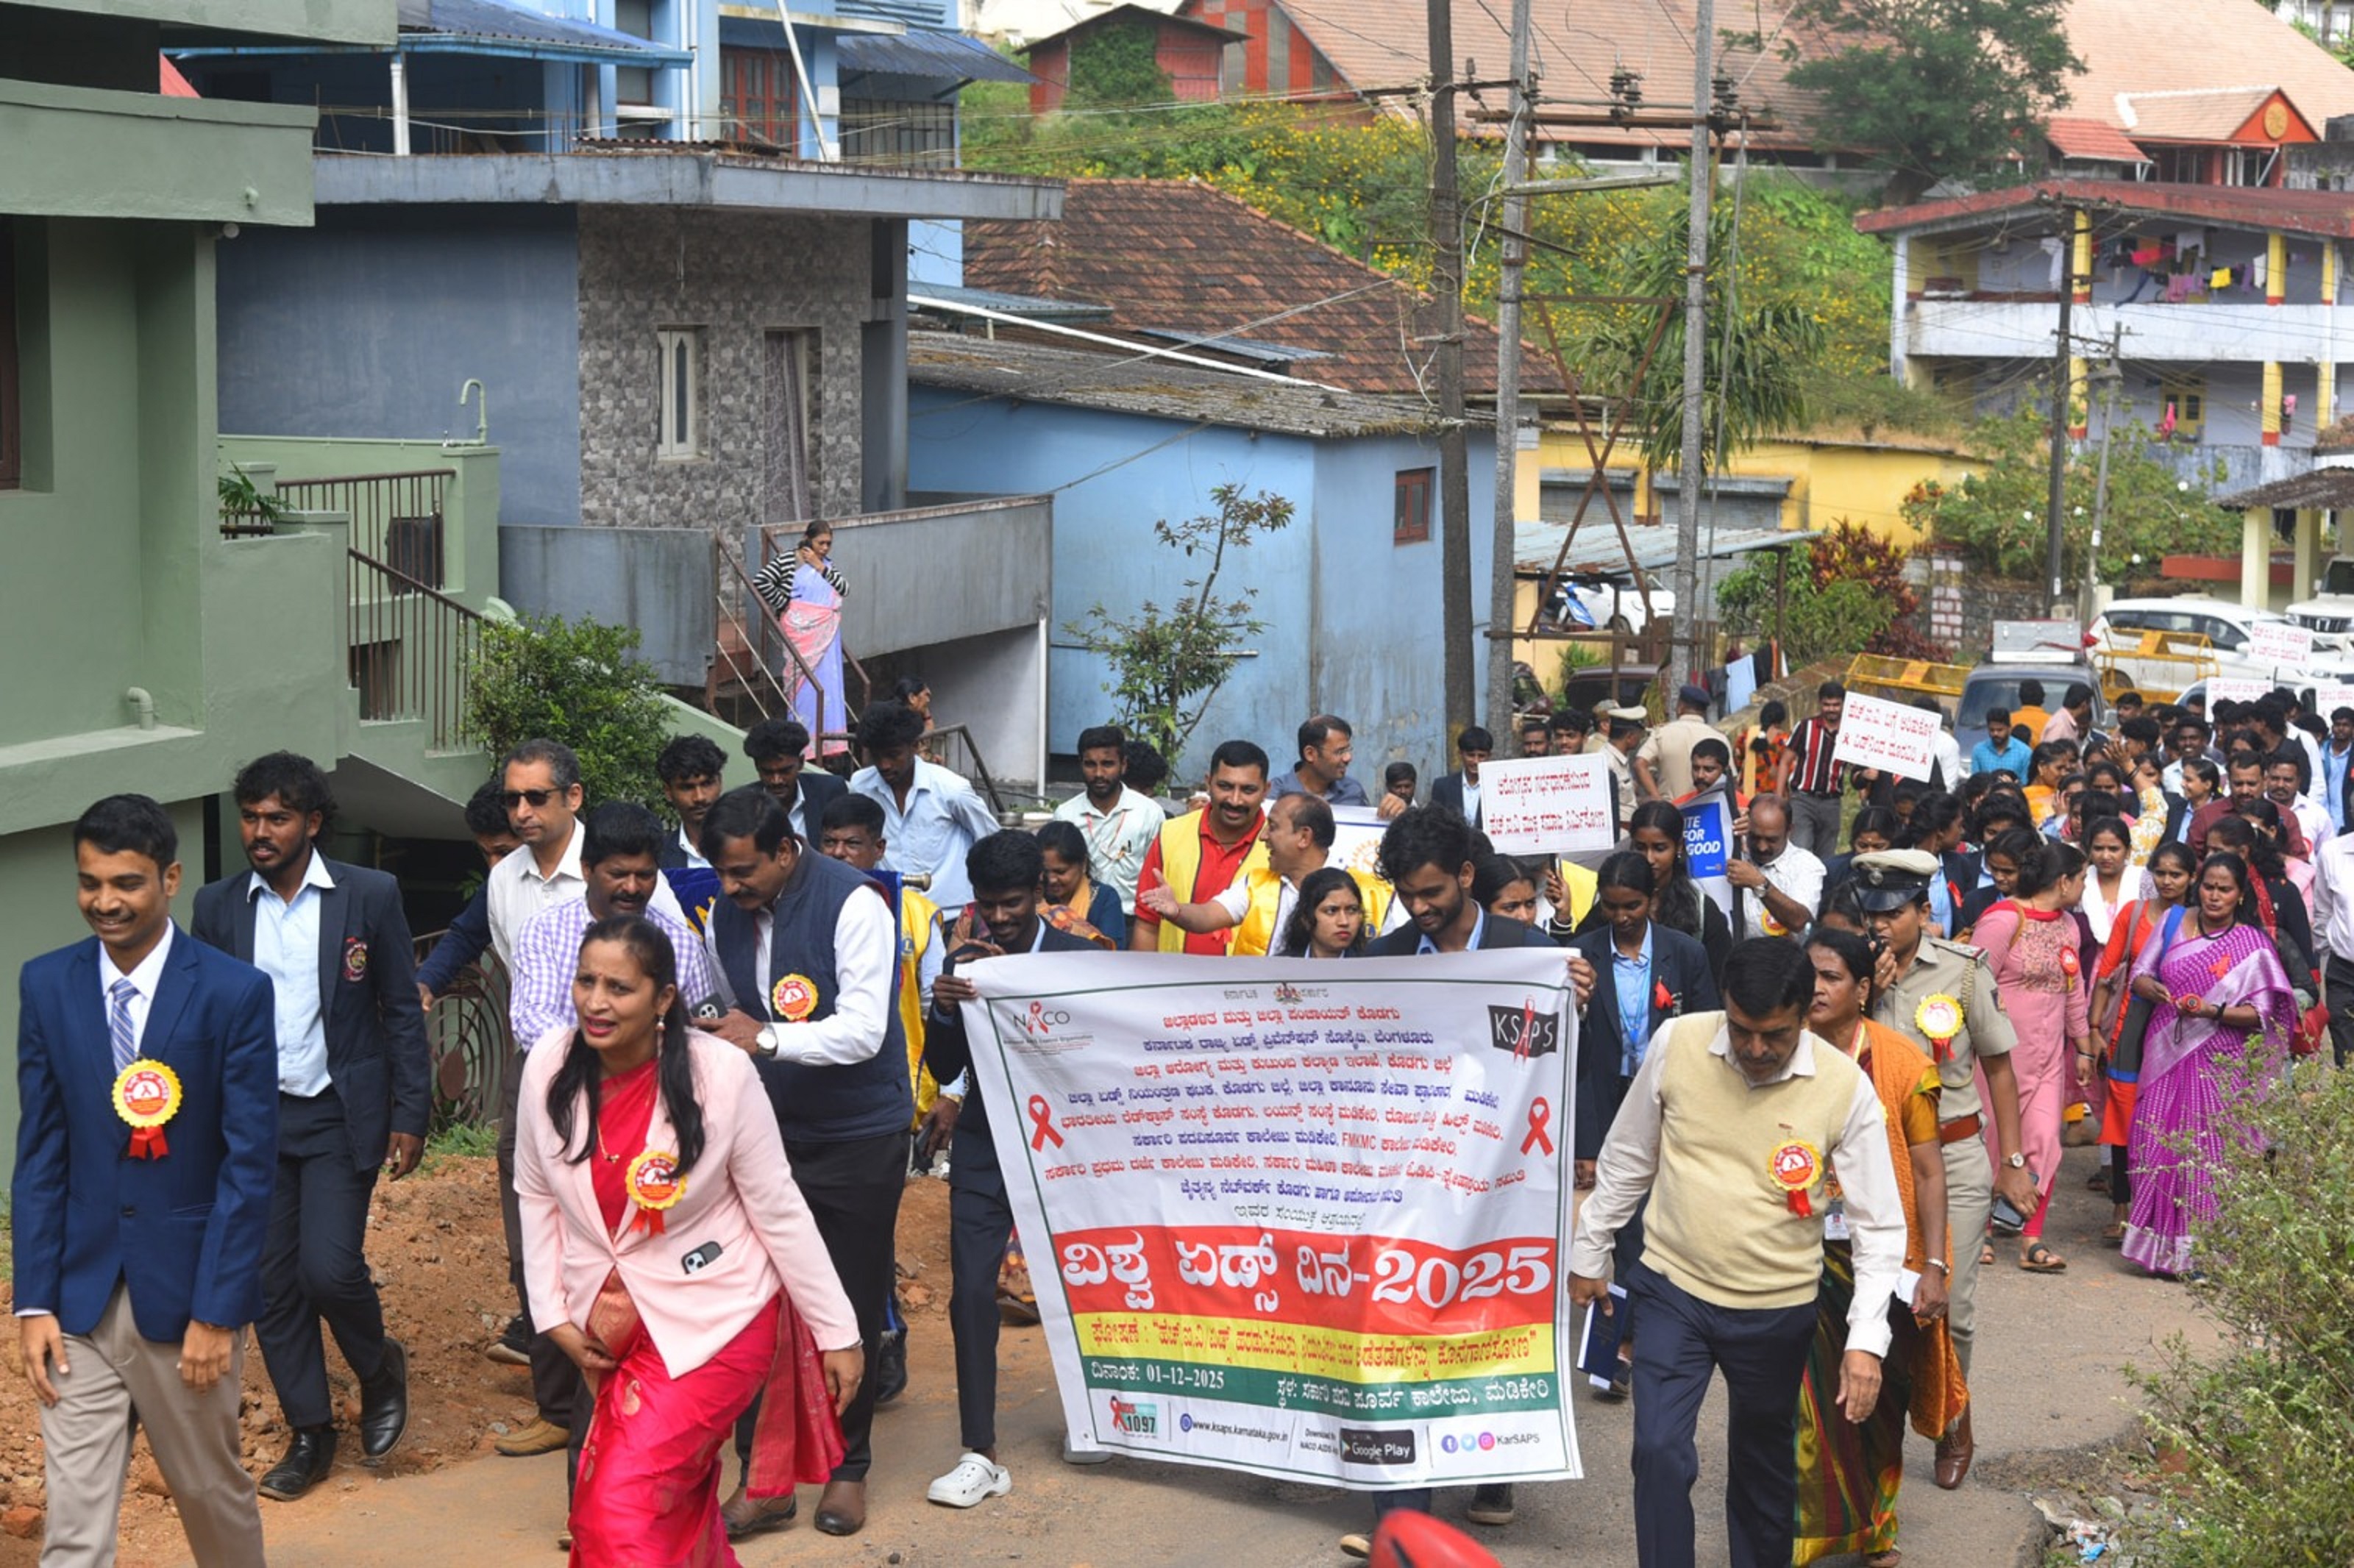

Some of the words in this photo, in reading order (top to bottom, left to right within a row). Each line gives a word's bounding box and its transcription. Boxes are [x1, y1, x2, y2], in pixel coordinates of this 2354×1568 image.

[1682, 829, 1704, 841] FOR
[1686, 841, 1721, 855] GOOD
[1013, 1004, 1070, 1032] NACO
[1223, 1011, 1252, 1027] ಮತ್ತು
[1257, 1009, 1284, 1025] ಜಿಲ್ಲಾ
[1288, 1005, 1351, 1021] ಪಂಚಾಯತ್
[1357, 1005, 1400, 1020] ಕೊಡಗು
[1142, 1037, 1193, 1052] ಕರ್ನಾಟಕ
[1199, 1036, 1231, 1052] ರಾಜ್ಯ
[1232, 1033, 1259, 1050] ಏಡ್ಸ್
[1373, 1030, 1434, 1044] ಬೆಂಗಳೂರು
[1494, 1012, 1554, 1050] KSAPS
[1134, 1063, 1161, 1080] ಜಿಲ್ಲಾ
[1165, 1059, 1215, 1078] ಆರೋಗ್ಯ
[1217, 1058, 1247, 1075] ಮತ್ತು
[1251, 1056, 1297, 1069] ಕುಟುಂಬ
[1301, 1055, 1339, 1074] ಕಲ್ಯಾಣ
[1387, 1052, 1429, 1070] ಕೊಡಗು
[1434, 1055, 1452, 1075] ಜಿಲ್ಲೆ
[1068, 1090, 1095, 1106] ಜಿಲ್ಲಾ
[1099, 1087, 1124, 1105] ಏಡ್ಸ್
[1128, 1086, 1181, 1102] ನಿಯಂತ್ರಣ
[1222, 1080, 1265, 1094] ಕೊಡಗು
[1298, 1080, 1324, 1097] ಜಿಲ್ಲಾ
[1329, 1078, 1376, 1093] ಕಾನೂನು
[1381, 1079, 1409, 1097] ಸೇವಾ
[1061, 1112, 1117, 1129] ಭಾರತೀಯ
[1133, 1132, 1173, 1146] ಸರ್ಕಾರಿ
[1246, 1127, 1290, 1142] ಕಾಲೇಜು
[1342, 1132, 1376, 1150] FMKMC
[1045, 1163, 1087, 1181] ಸರ್ಕಾರಿ
[1091, 1160, 1125, 1177] ಪ್ರಥಮ
[1130, 1156, 1154, 1170] ದರ್ಜೆ
[1161, 1155, 1204, 1169] ಕಾಲೇಜು
[1264, 1154, 1300, 1170] ಸರ್ಕಾರಿ
[1276, 1180, 1310, 1197] ಕೊಡಗು
[1234, 1204, 1269, 1218] ಇವರ
[1063, 1229, 1155, 1310] ವಿಶ್ವ
[1175, 1233, 1279, 1312] ಏಡ್ಸ್
[1296, 1239, 1551, 1309] ದಿನ-2025
[1092, 1361, 1140, 1380] ದಿನಾಂಕ:
[1146, 1364, 1225, 1389] 01-12-2025
[1354, 1387, 1404, 1409] ಪೂರ್ವ
[1411, 1383, 1479, 1405] ಕಾಲೇಜು,
[1484, 1376, 1550, 1400] ಮಡಿಕೇರಿ
[1127, 1414, 1156, 1433] 1097
[1192, 1421, 1288, 1442] www.ksaps.karnataka.gov.in
[1496, 1433, 1540, 1445] KarSAPS
[1352, 1442, 1383, 1460] Google
[1384, 1443, 1410, 1458] Play
